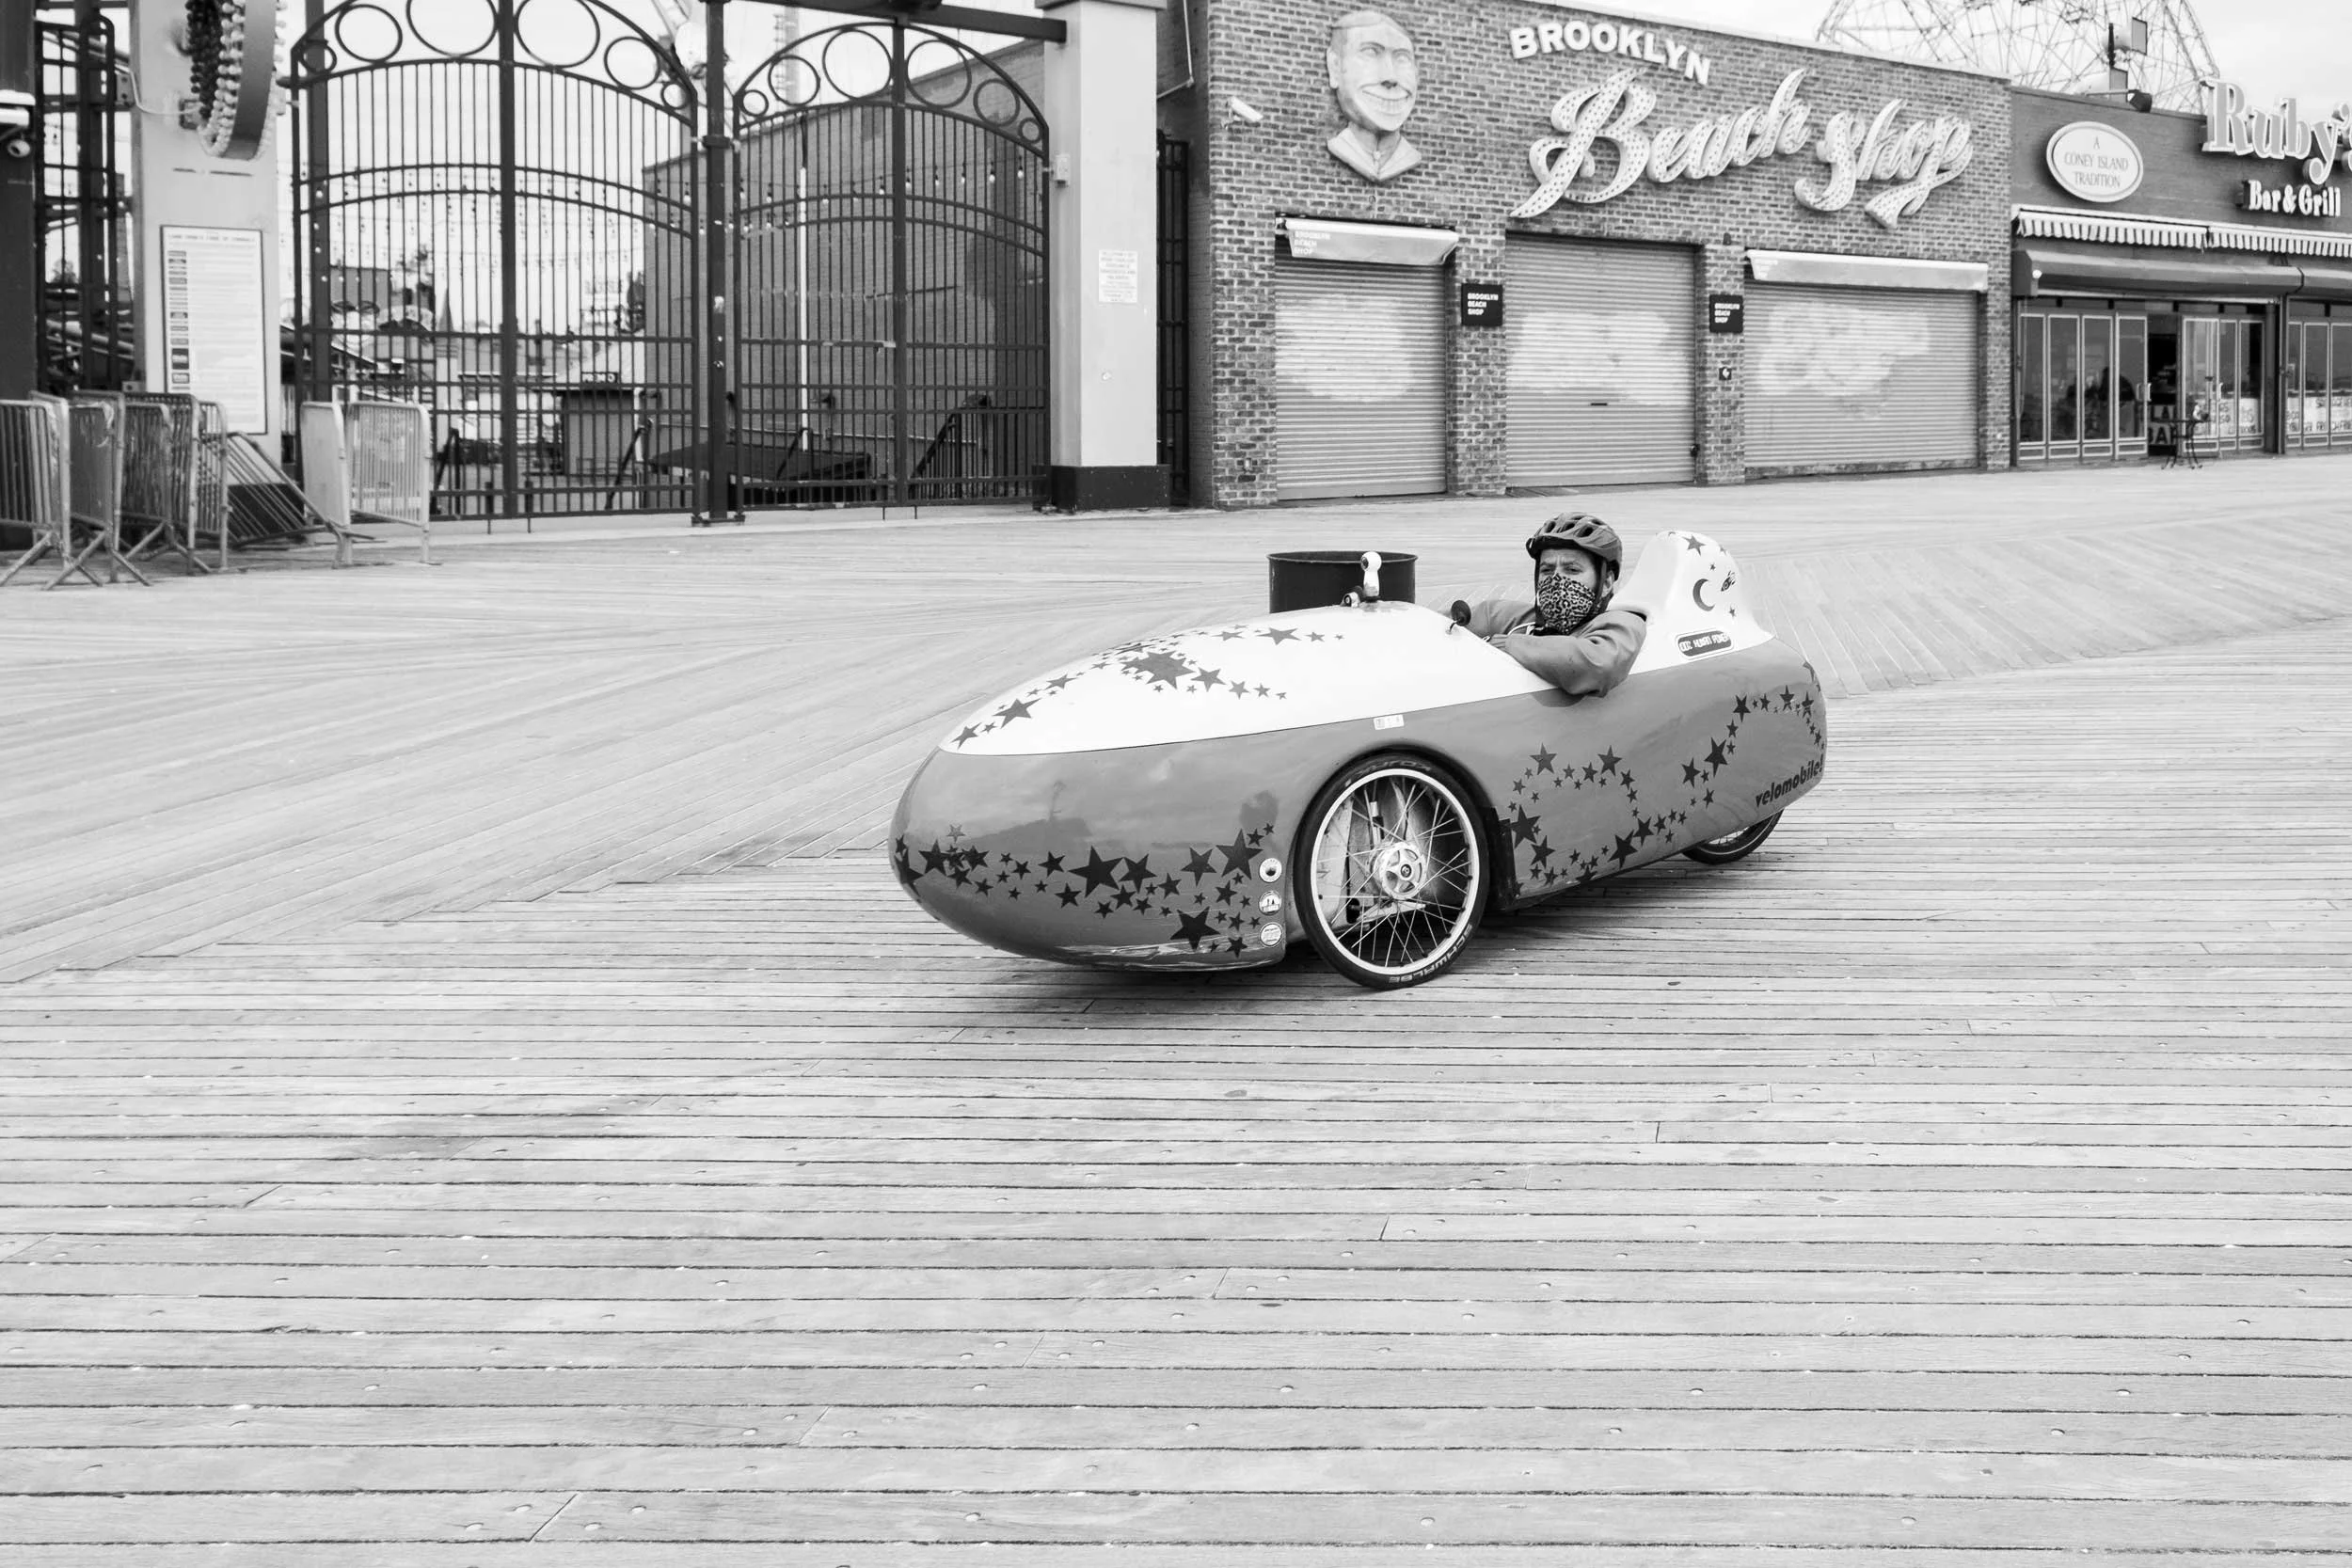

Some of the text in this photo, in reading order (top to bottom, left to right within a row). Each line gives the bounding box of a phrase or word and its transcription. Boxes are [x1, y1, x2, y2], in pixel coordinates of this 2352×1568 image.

[1509, 20, 1710, 86] BROOKLYN
[1509, 67, 1973, 229] Beach Shop
[2093, 135, 2101, 150] A
[2064, 151, 2129, 170] CONEY ISLAND
[2073, 171, 2121, 189] TRADITION
[1468, 293, 1499, 301] BROOKLYN
[1468, 300, 1486, 309] BEACH
[1468, 308, 1485, 316] SHOP
[1756, 753, 1823, 808] velomobile!
